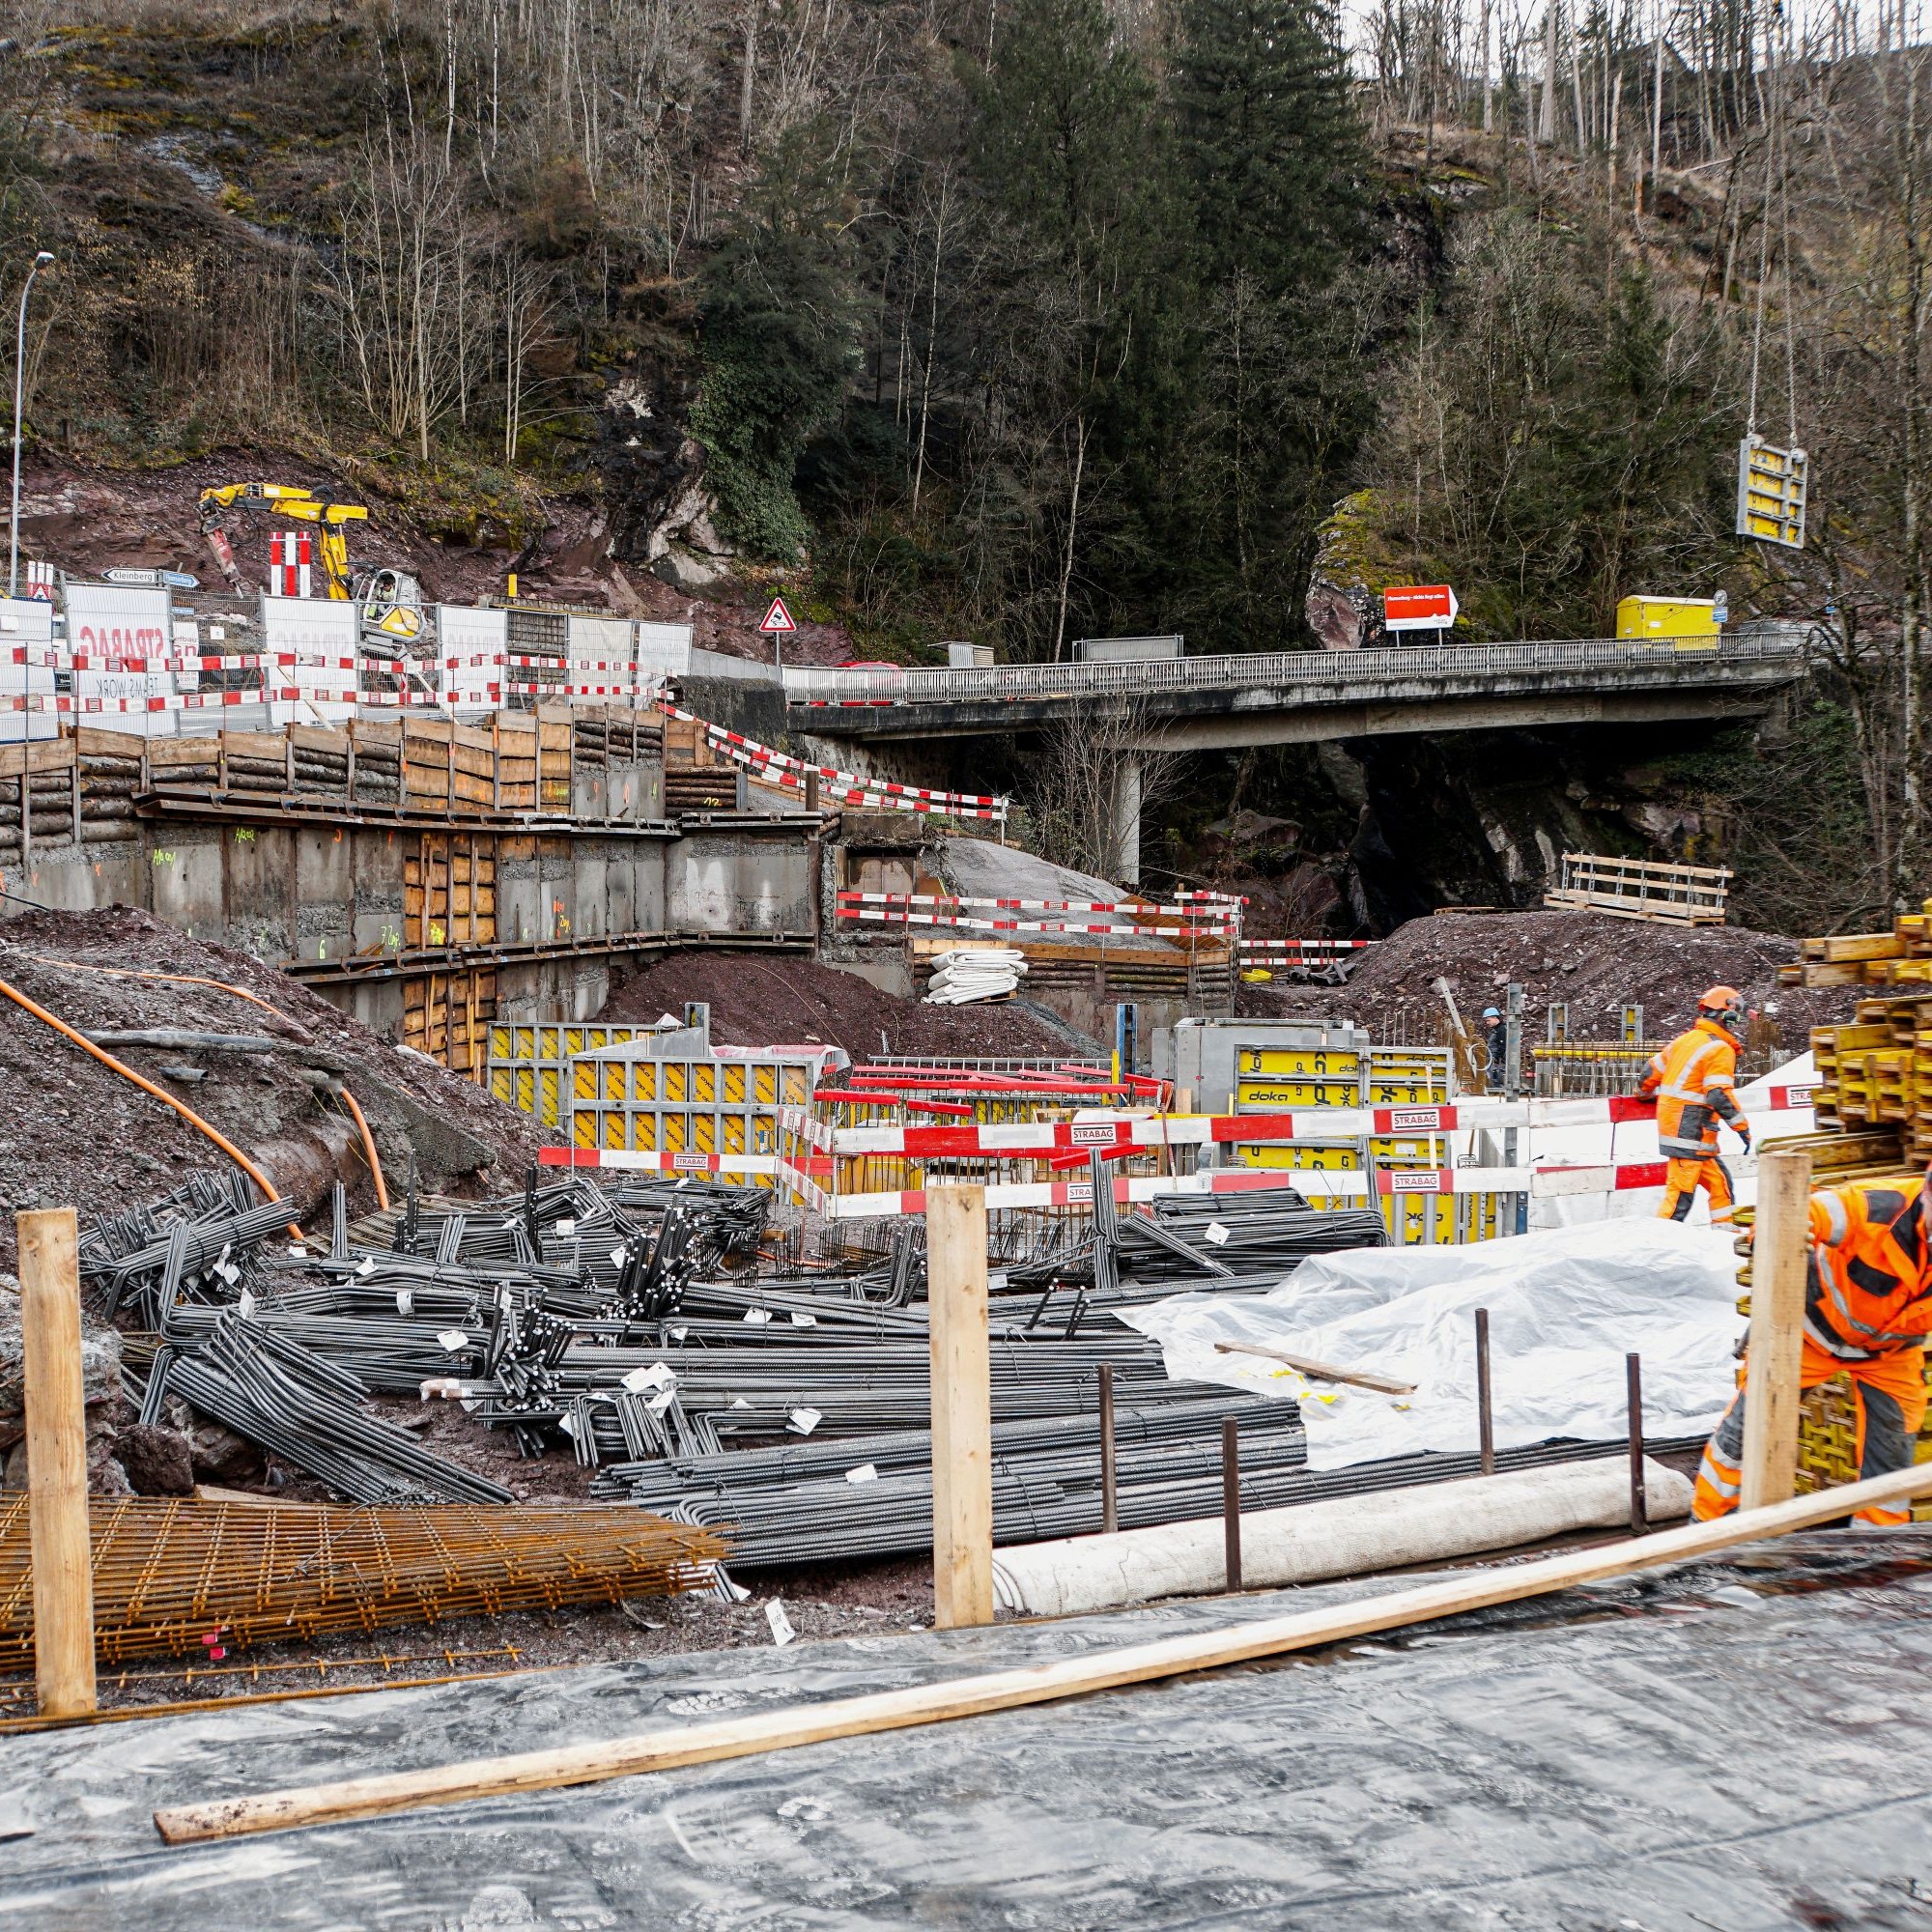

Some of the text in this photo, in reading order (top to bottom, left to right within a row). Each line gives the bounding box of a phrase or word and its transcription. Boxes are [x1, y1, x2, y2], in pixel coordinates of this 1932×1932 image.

[113, 571, 153, 582] Kleinberg
[580, 1076, 596, 1093] doka
[756, 1080, 774, 1097] doka
[1248, 1091, 1289, 1102] doka
[1394, 1115, 1437, 1125] STRABAG
[607, 1122, 623, 1140] doka
[698, 1128, 715, 1145] doka
[1073, 1129, 1114, 1139] STRABAG
[1394, 1177, 1437, 1186] STRABAG
